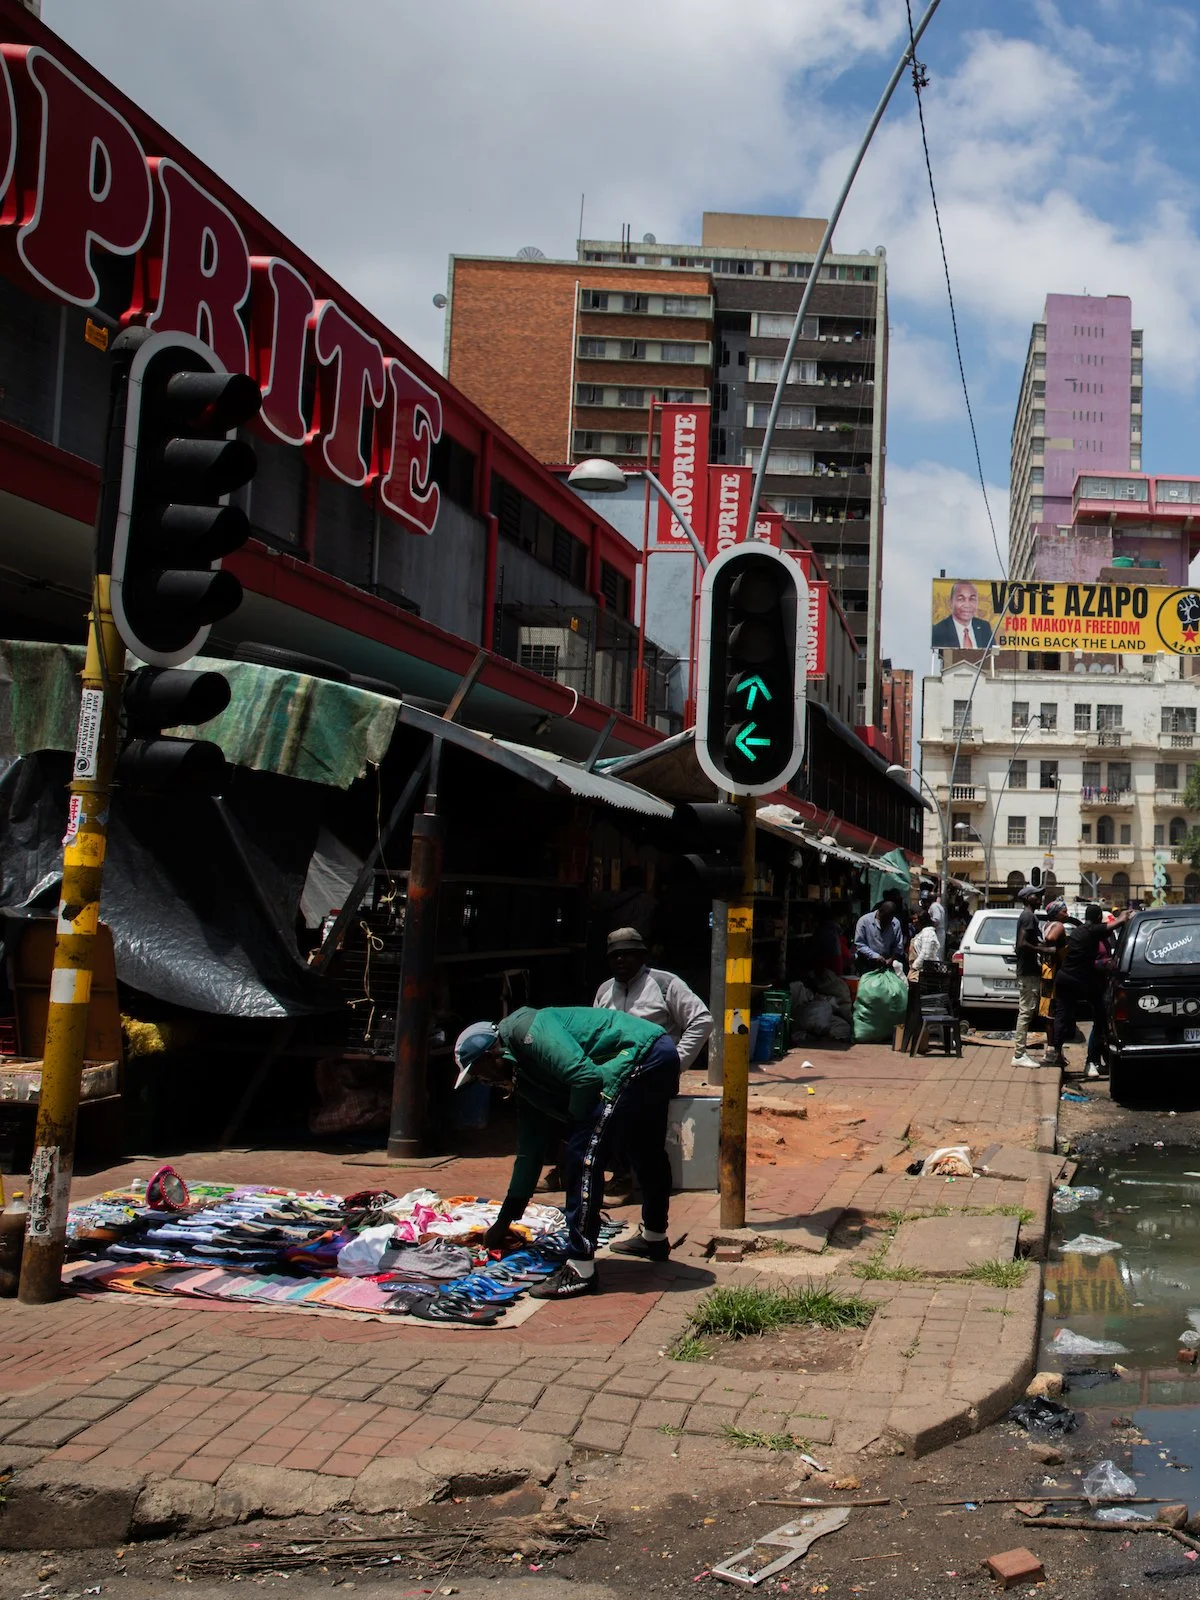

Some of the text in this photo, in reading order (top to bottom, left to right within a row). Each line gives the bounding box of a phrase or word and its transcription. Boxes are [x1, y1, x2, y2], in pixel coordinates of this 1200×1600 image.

[0, 44, 443, 535] PRITE
[717, 473, 740, 552] OPRITE
[990, 582, 1148, 619] VOTE AZAPO
[1005, 617, 1140, 635] FOR MAKOYA FREEDOM
[1000, 635, 1146, 650] BRING BACK THE LAND
[1151, 935, 1193, 959] Izalawi
